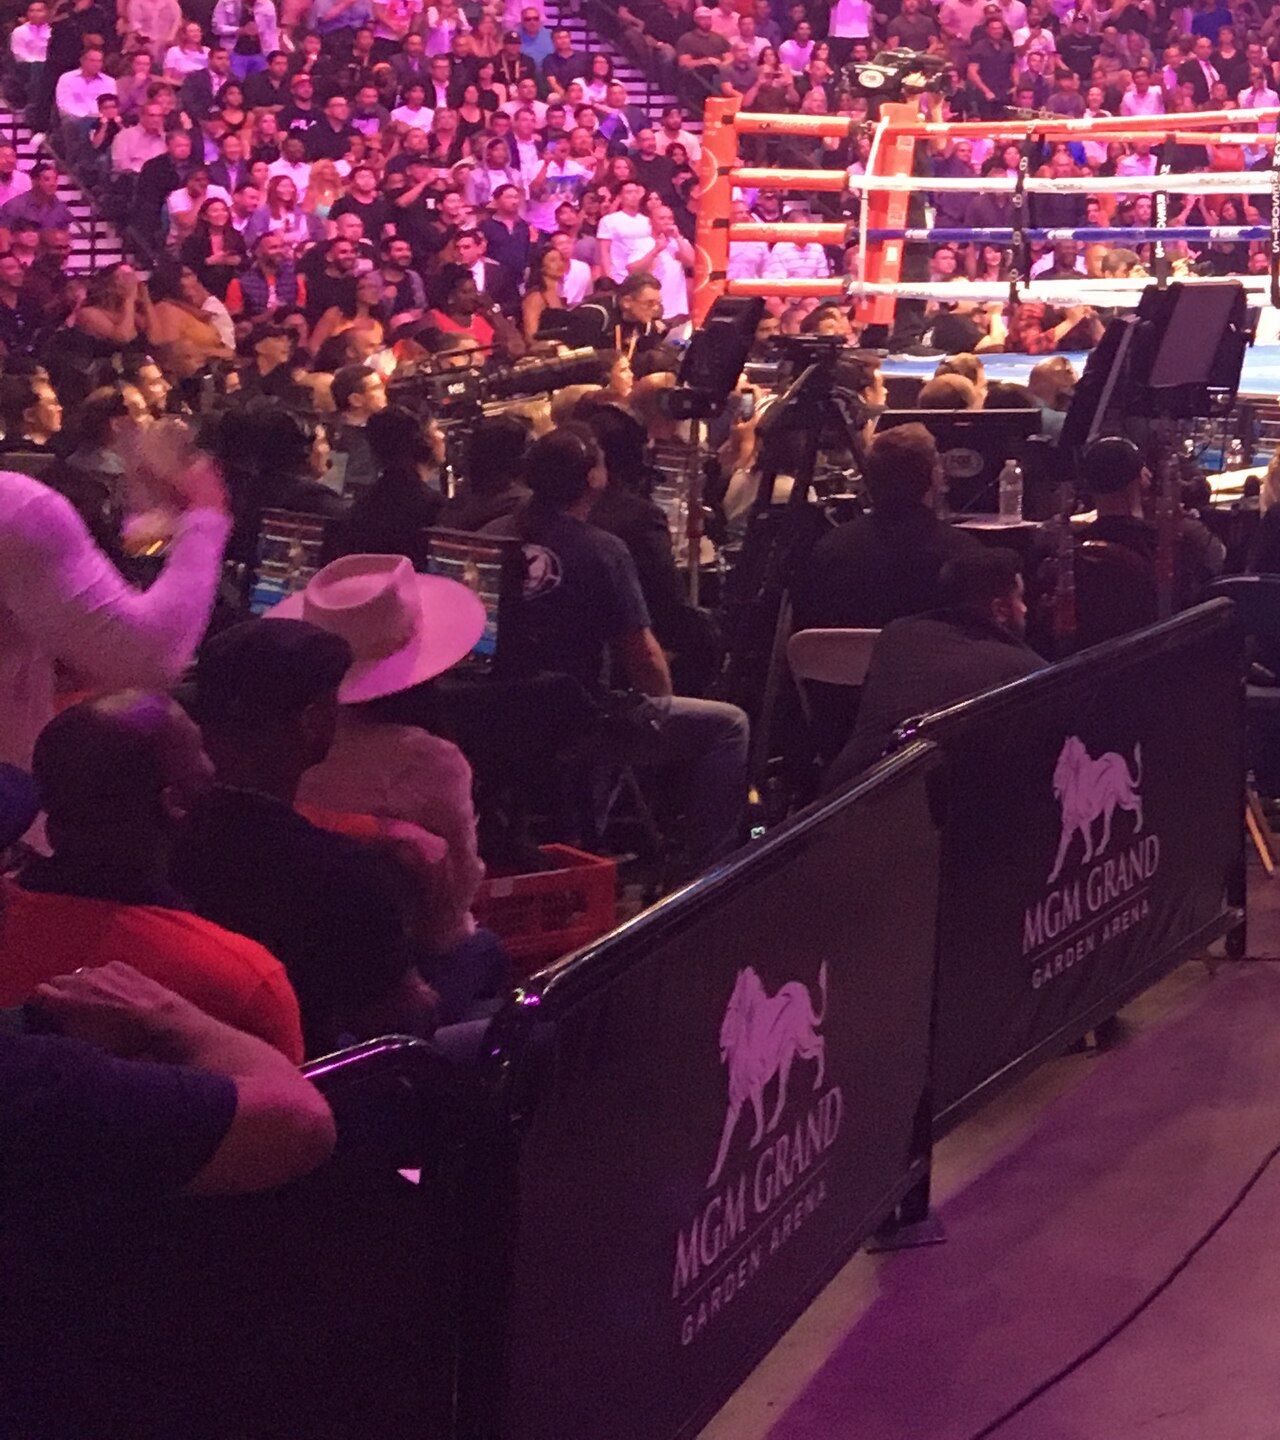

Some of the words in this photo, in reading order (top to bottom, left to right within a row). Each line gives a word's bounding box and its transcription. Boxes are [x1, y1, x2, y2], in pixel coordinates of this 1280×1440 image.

[1022, 878, 1082, 955] MGM
[1086, 834, 1161, 912] GRAND
[1031, 937, 1096, 990] GARDEN
[1102, 898, 1150, 941] ARENA
[672, 1176, 746, 1298] MGM
[753, 1086, 844, 1215] GRAND
[680, 1247, 762, 1346] GARDEN
[769, 1180, 828, 1255] ARENA
